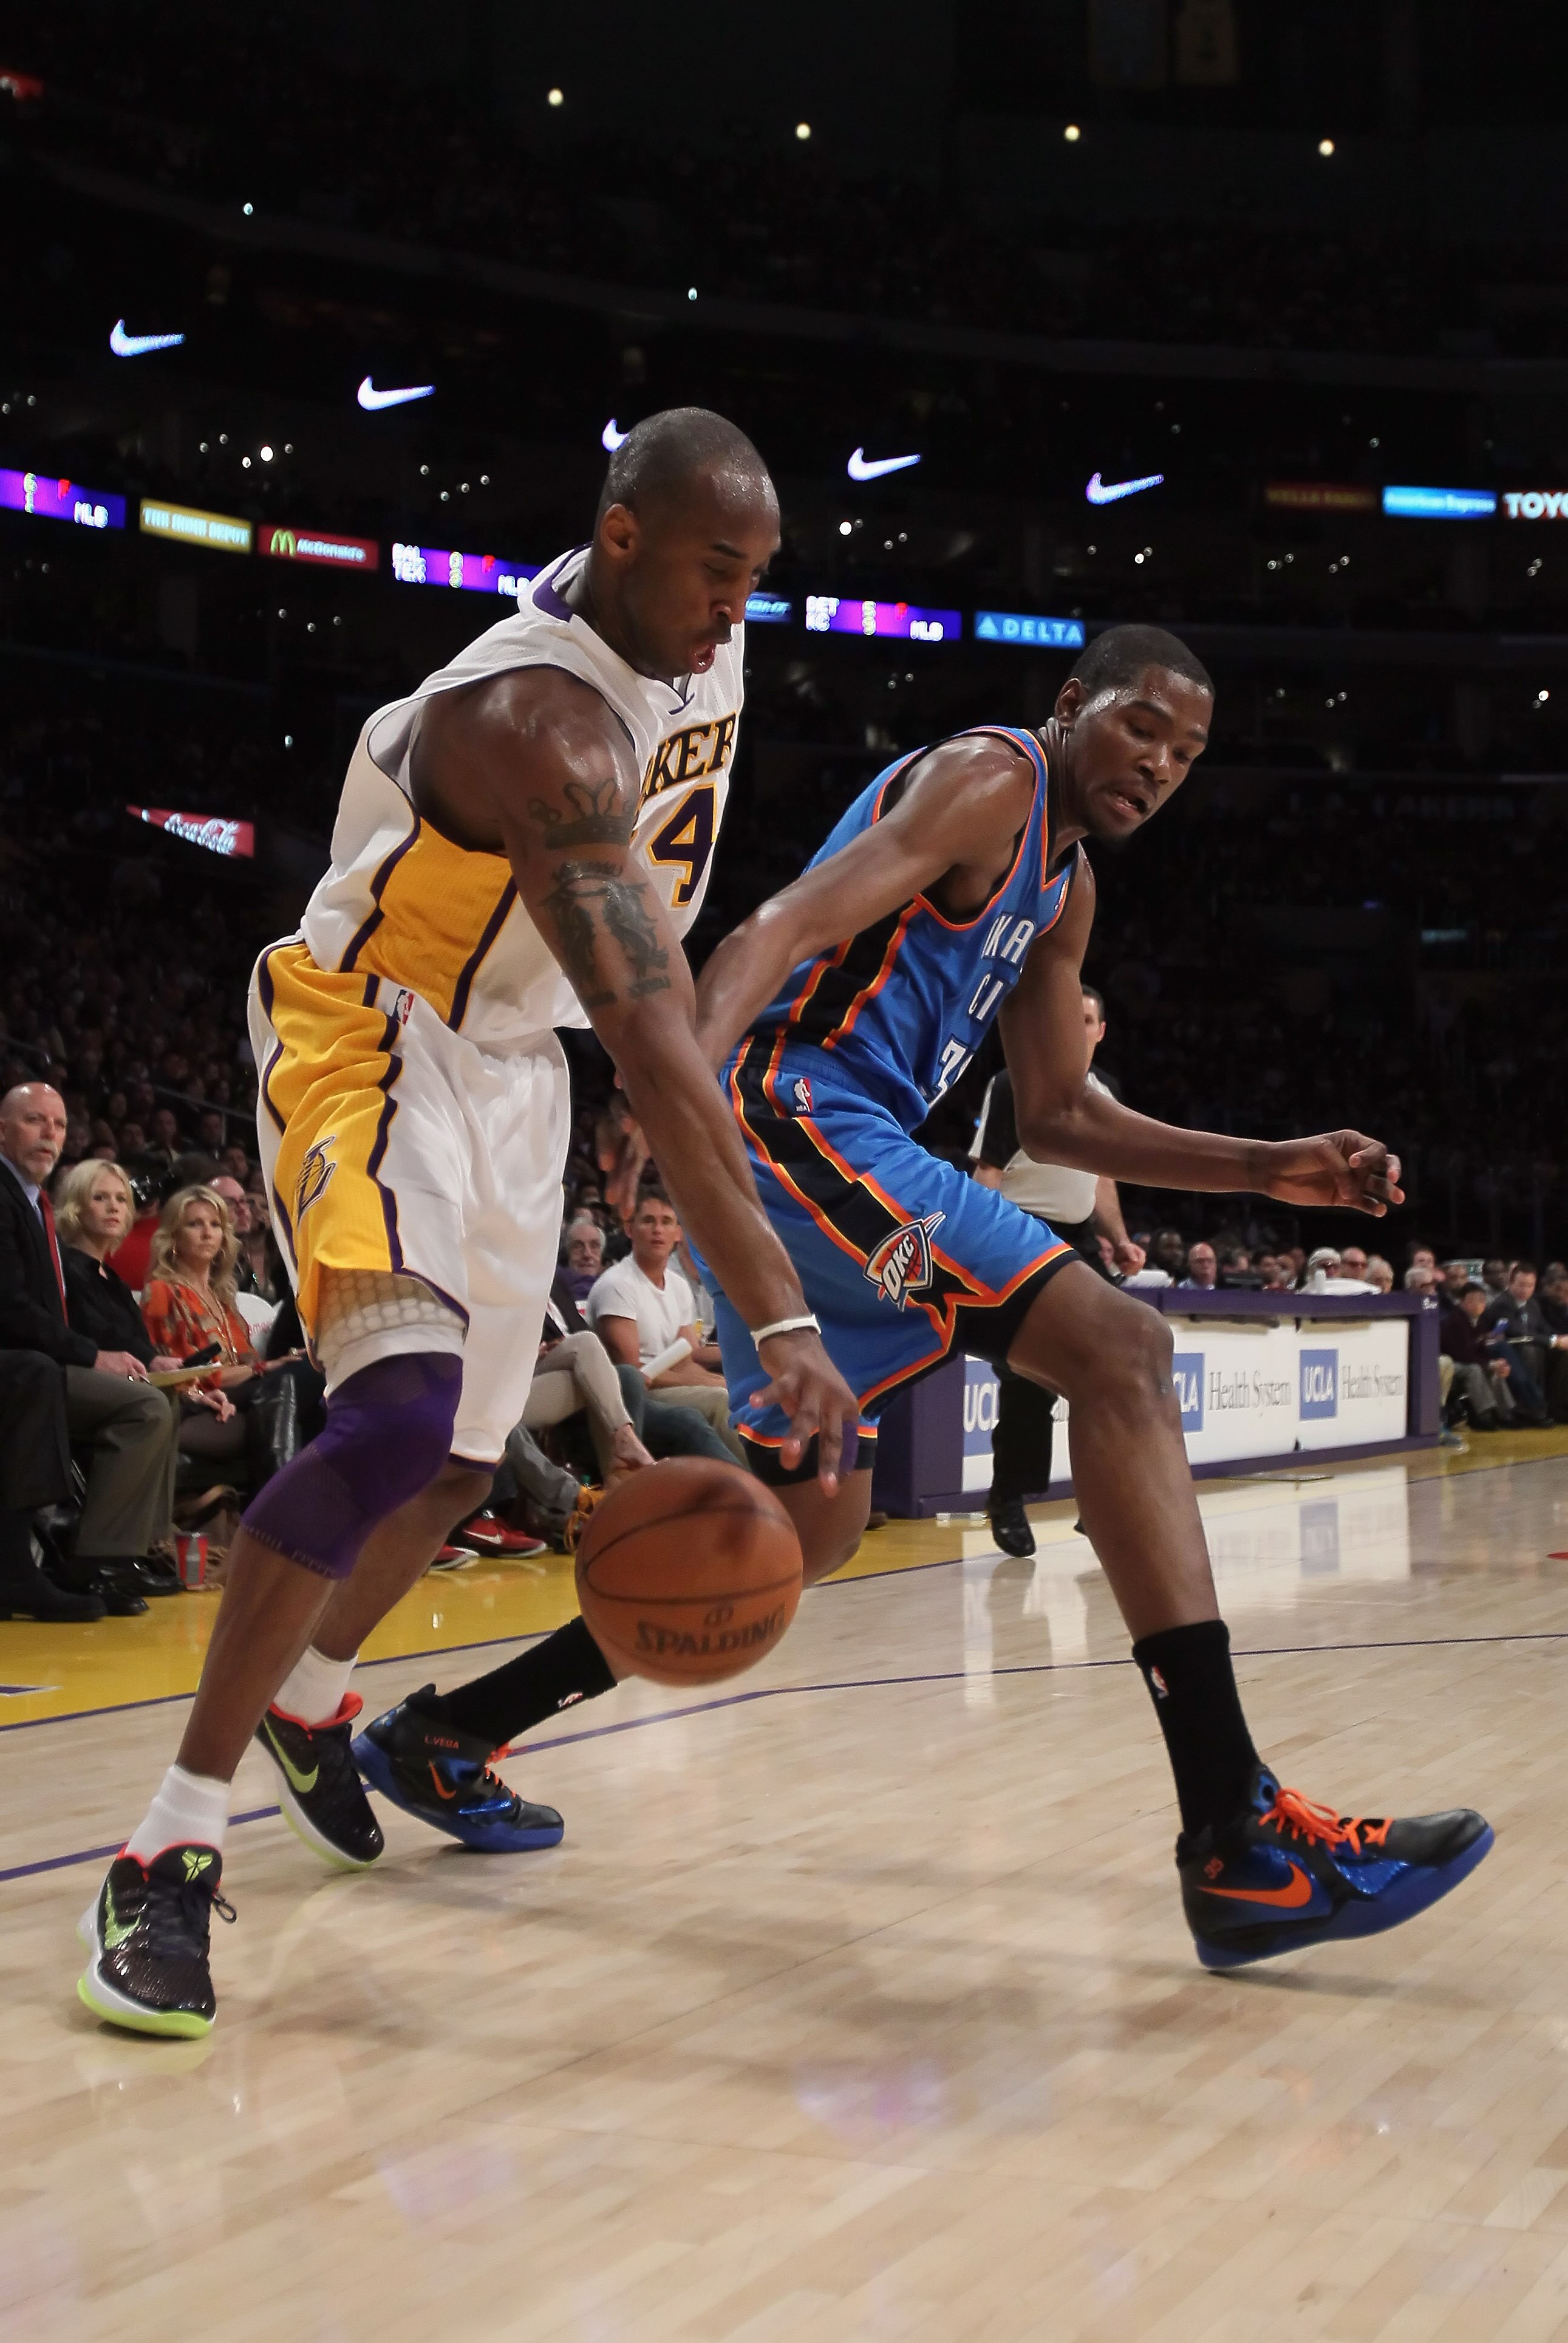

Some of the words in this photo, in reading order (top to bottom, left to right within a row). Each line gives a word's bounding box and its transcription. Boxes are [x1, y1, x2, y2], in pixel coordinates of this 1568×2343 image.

[73, 500, 109, 528] MLB
[296, 538, 366, 563] McDonald's
[394, 558, 426, 584] TEX
[910, 620, 944, 641] MLB
[1002, 617, 1082, 643] DELTA
[881, 1234, 915, 1304] OKC
[1208, 1370, 1250, 1411] Health
[1253, 1370, 1292, 1417] System
[1304, 1366, 1334, 1403] UCLA
[1341, 1364, 1371, 1400] Health
[963, 1383, 1001, 1432] UCL
[635, 1604, 786, 1657] SPALDING
